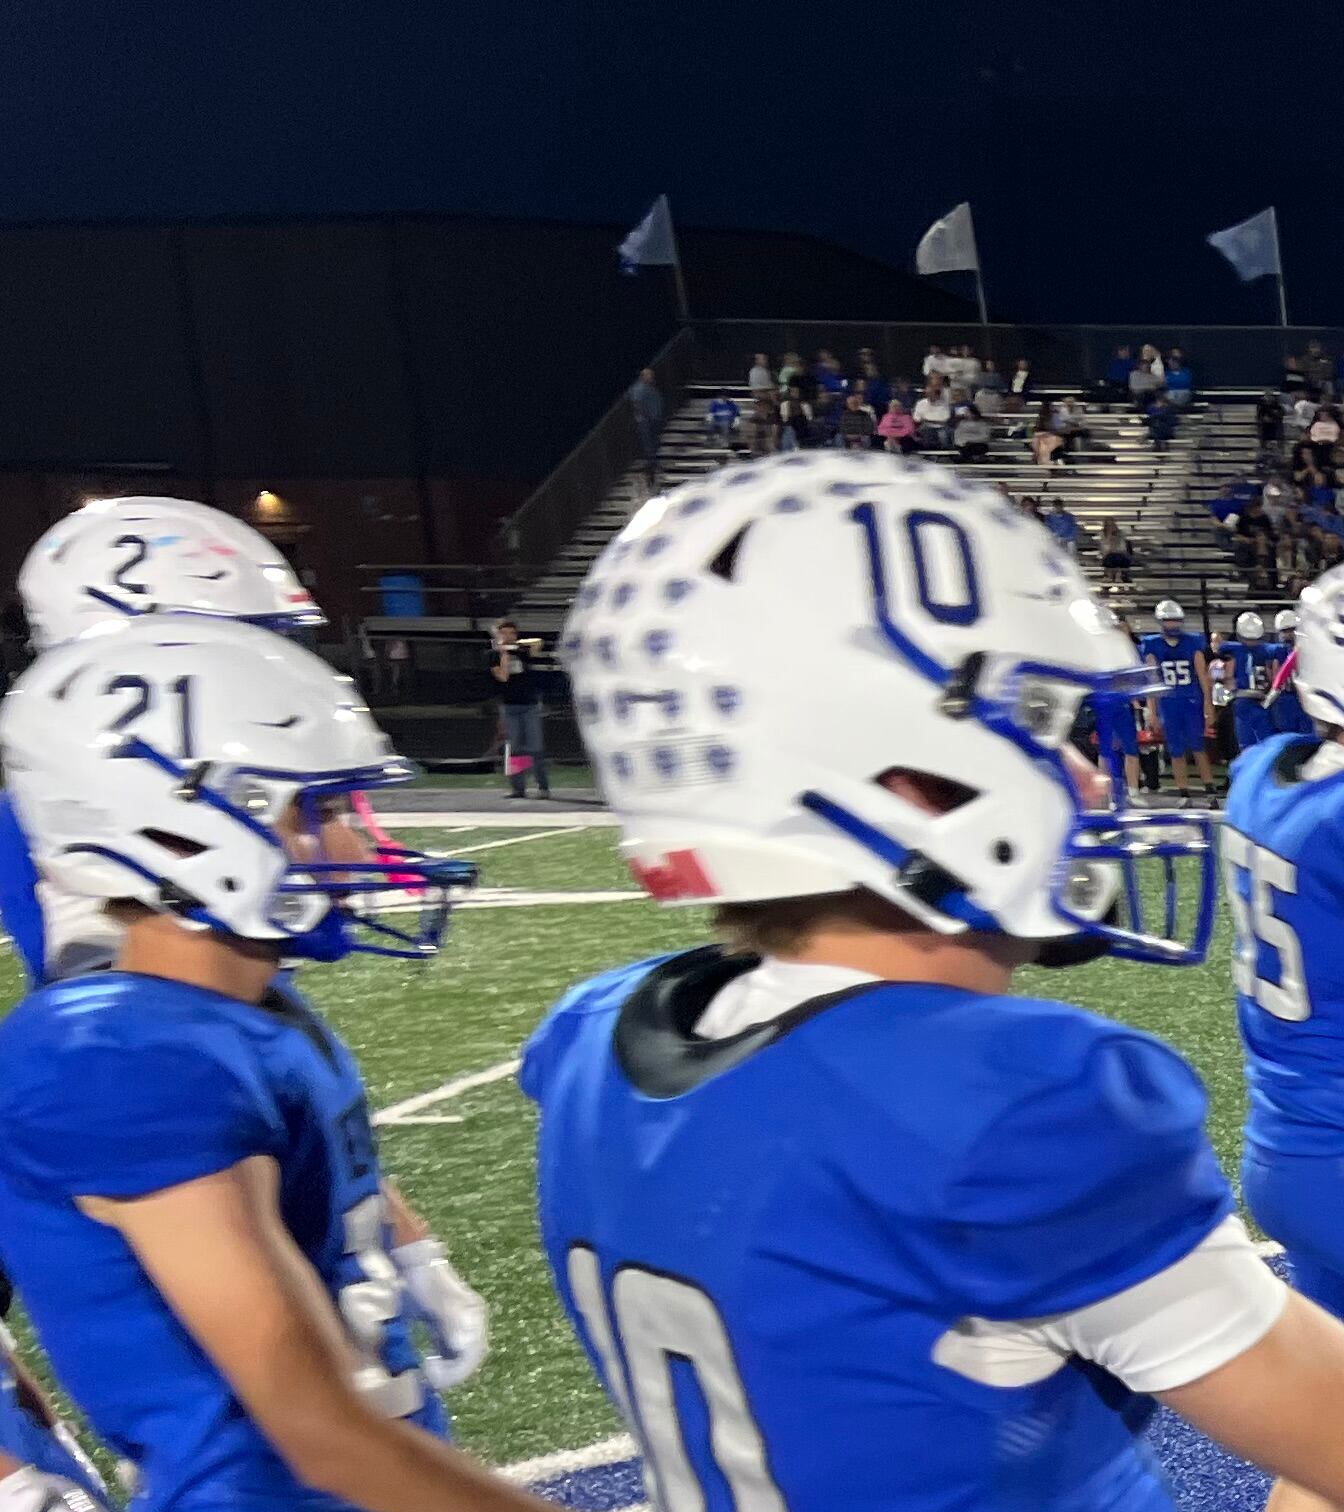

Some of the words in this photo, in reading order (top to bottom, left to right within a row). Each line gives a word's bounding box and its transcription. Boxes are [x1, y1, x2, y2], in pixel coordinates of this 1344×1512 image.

[111, 535, 150, 595] 2
[846, 502, 980, 625] 10
[1161, 660, 1192, 686] 65
[105, 675, 196, 760] 21
[1219, 823, 1312, 1022] 55
